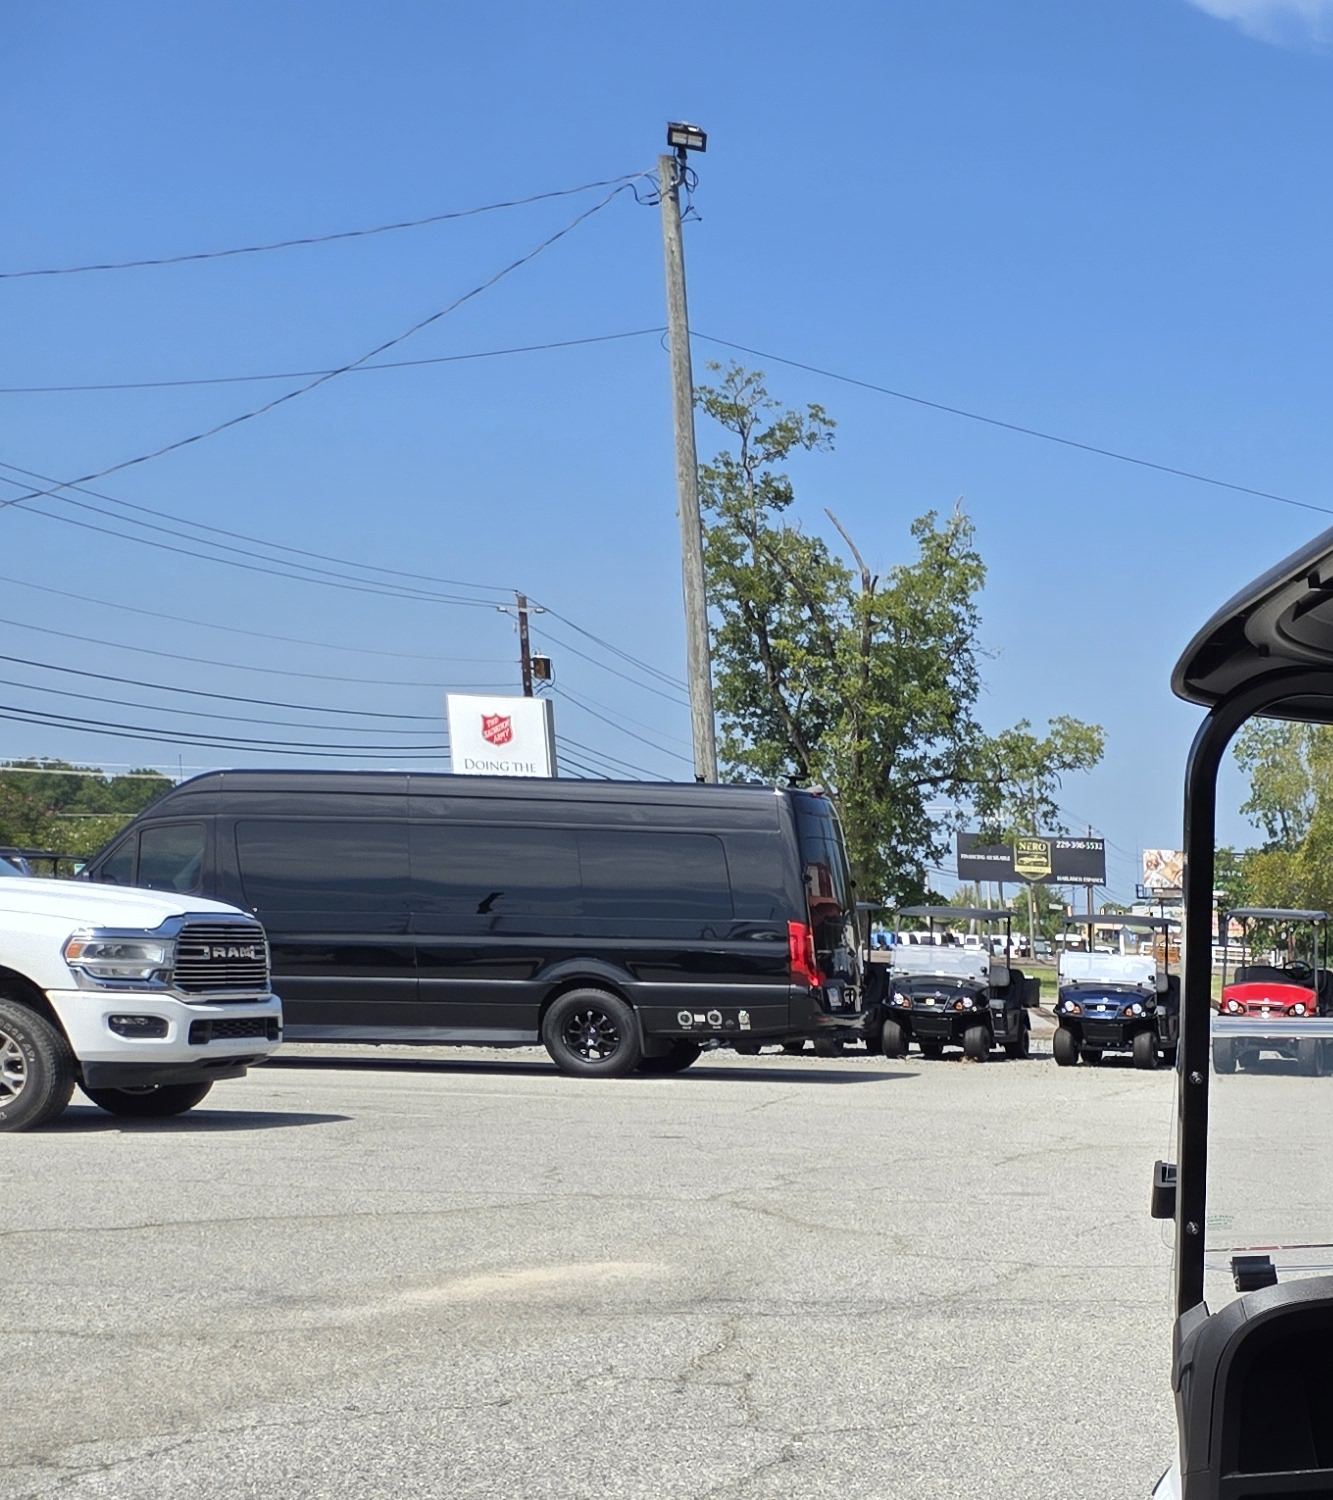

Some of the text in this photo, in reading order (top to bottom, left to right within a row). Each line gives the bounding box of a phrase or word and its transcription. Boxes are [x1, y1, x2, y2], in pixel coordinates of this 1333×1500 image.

[464, 758, 537, 773] DOING THE
[1018, 841, 1046, 851] NERO
[212, 945, 255, 958] RAM
